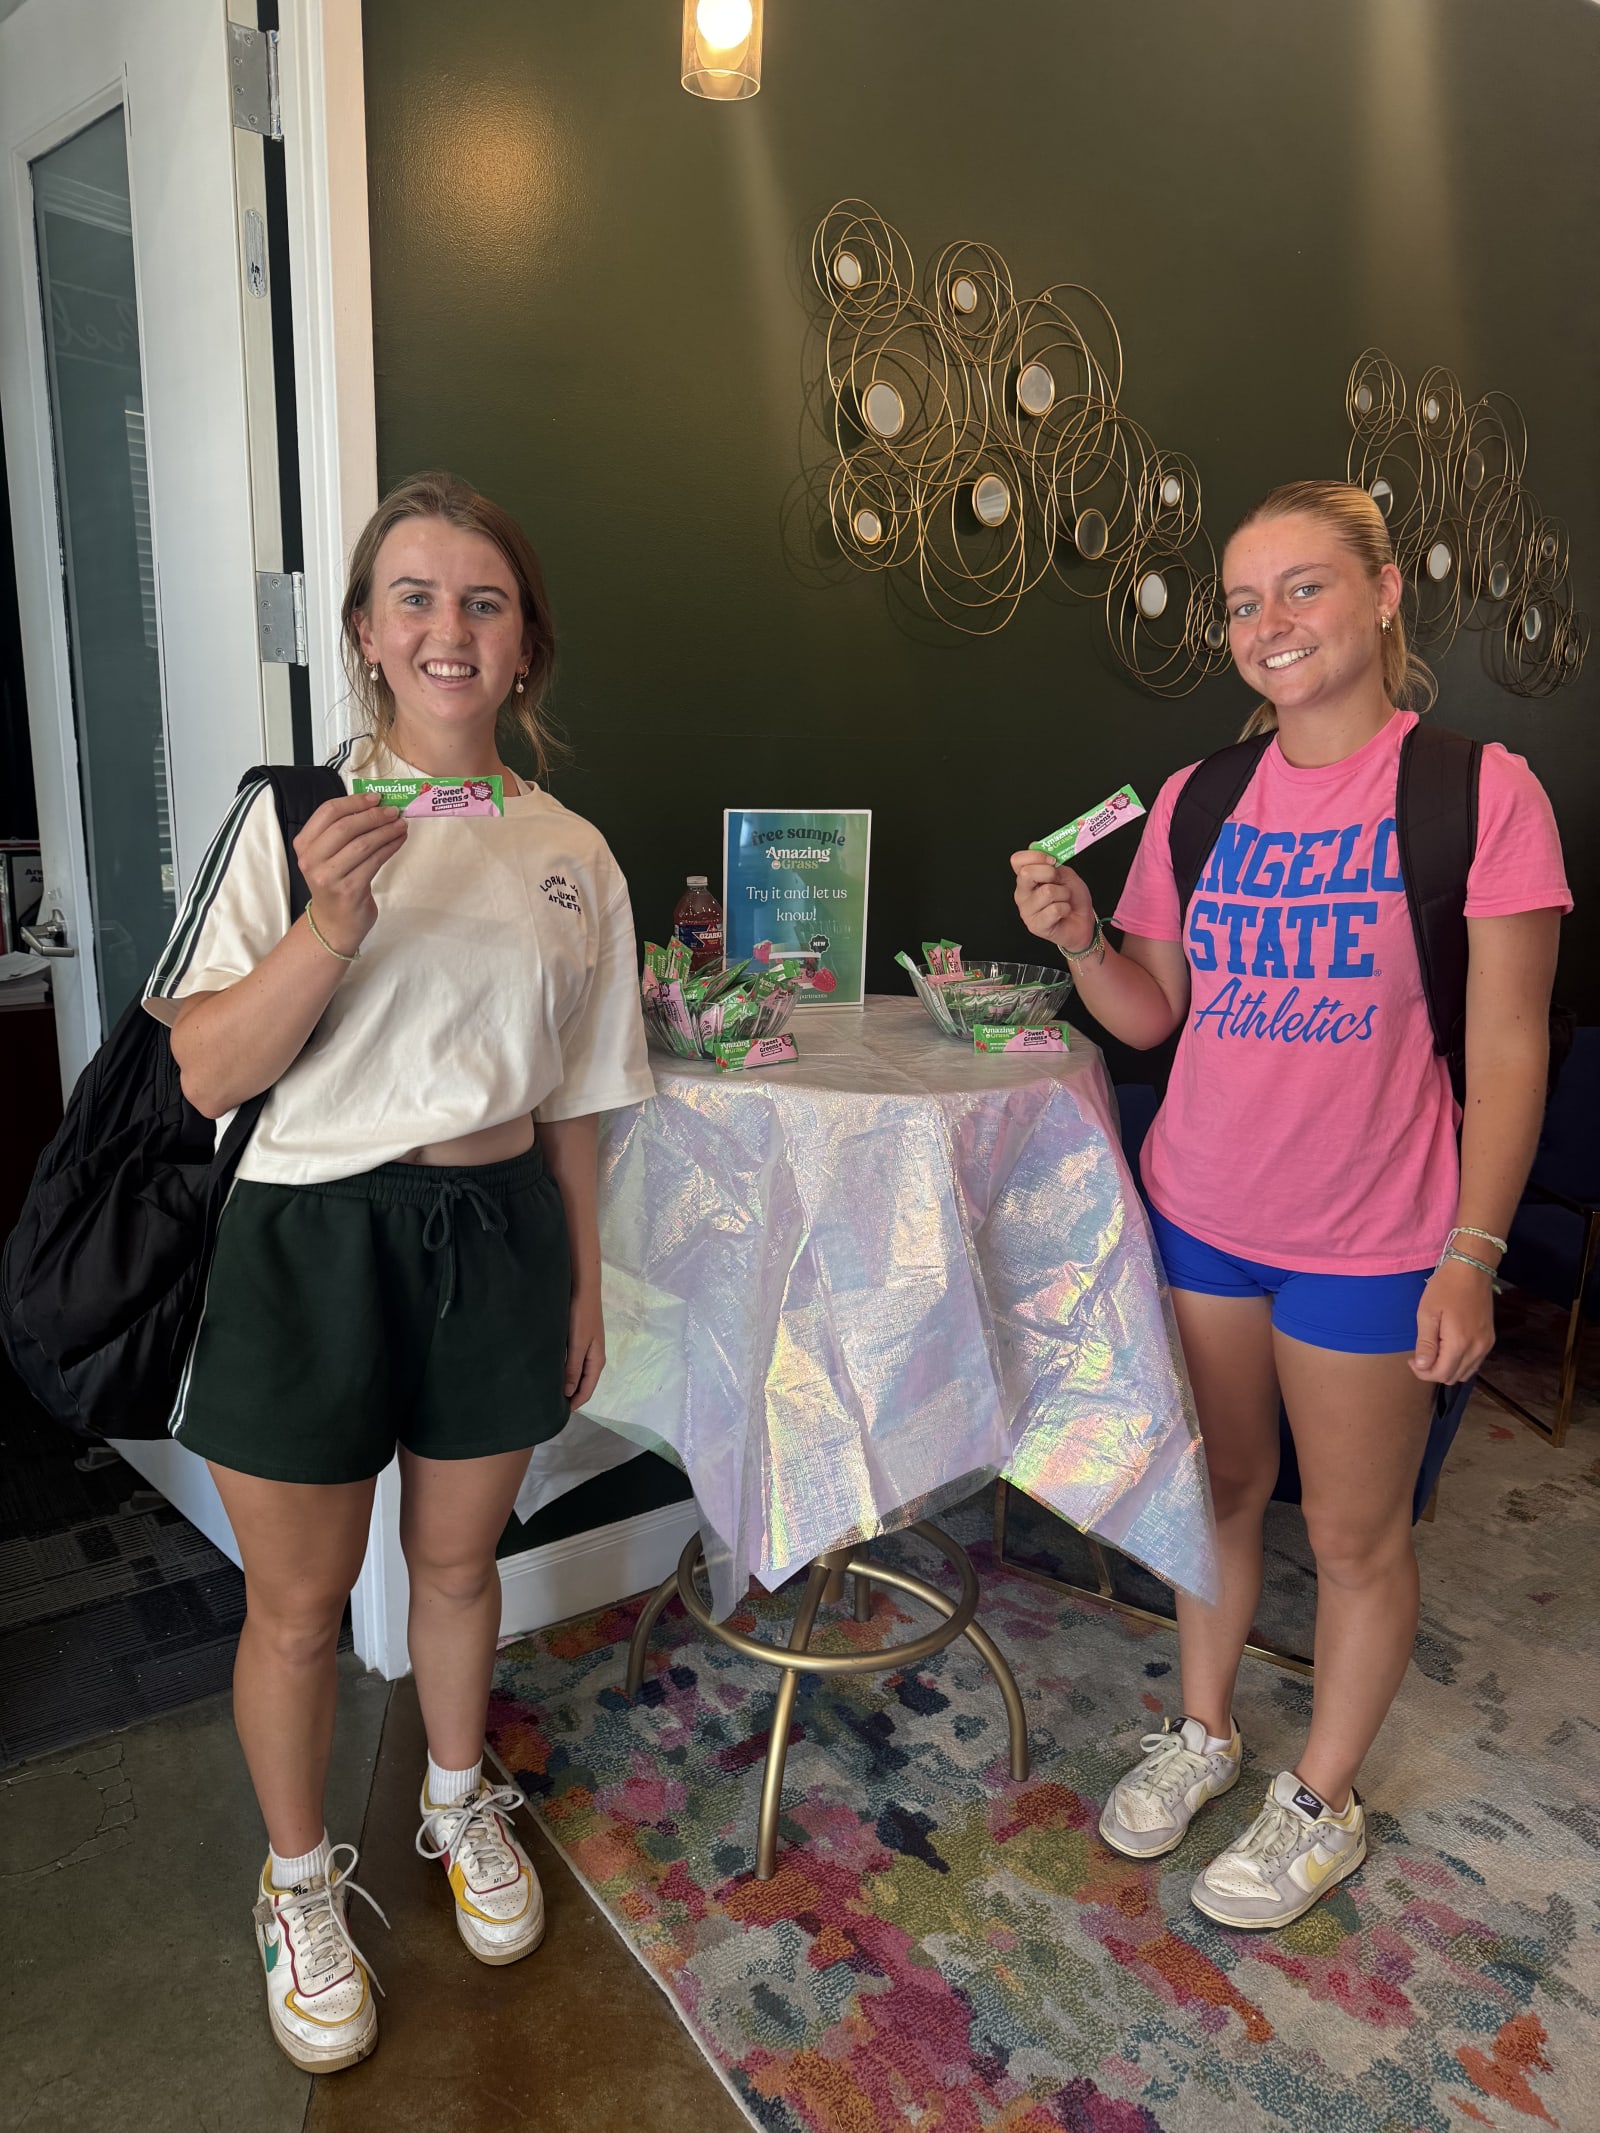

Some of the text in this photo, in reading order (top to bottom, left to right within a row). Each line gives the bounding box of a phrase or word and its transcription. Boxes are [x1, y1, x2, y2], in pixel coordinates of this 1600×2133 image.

[365, 783, 417, 795] Amazing
[437, 787, 464, 797] Sweet
[432, 794, 463, 804] Greens
[1089, 814, 1111, 832] Greens
[752, 828, 845, 847] free sample
[765, 846, 831, 862] Amazing
[1194, 817, 1406, 898] NGELO
[781, 860, 818, 870] Grass
[540, 875, 566, 892] LORNA
[746, 886, 847, 902] Try it and let us
[776, 906, 817, 921] know!
[1189, 899, 1378, 979] STATE
[1194, 977, 1378, 1044] Athletics
